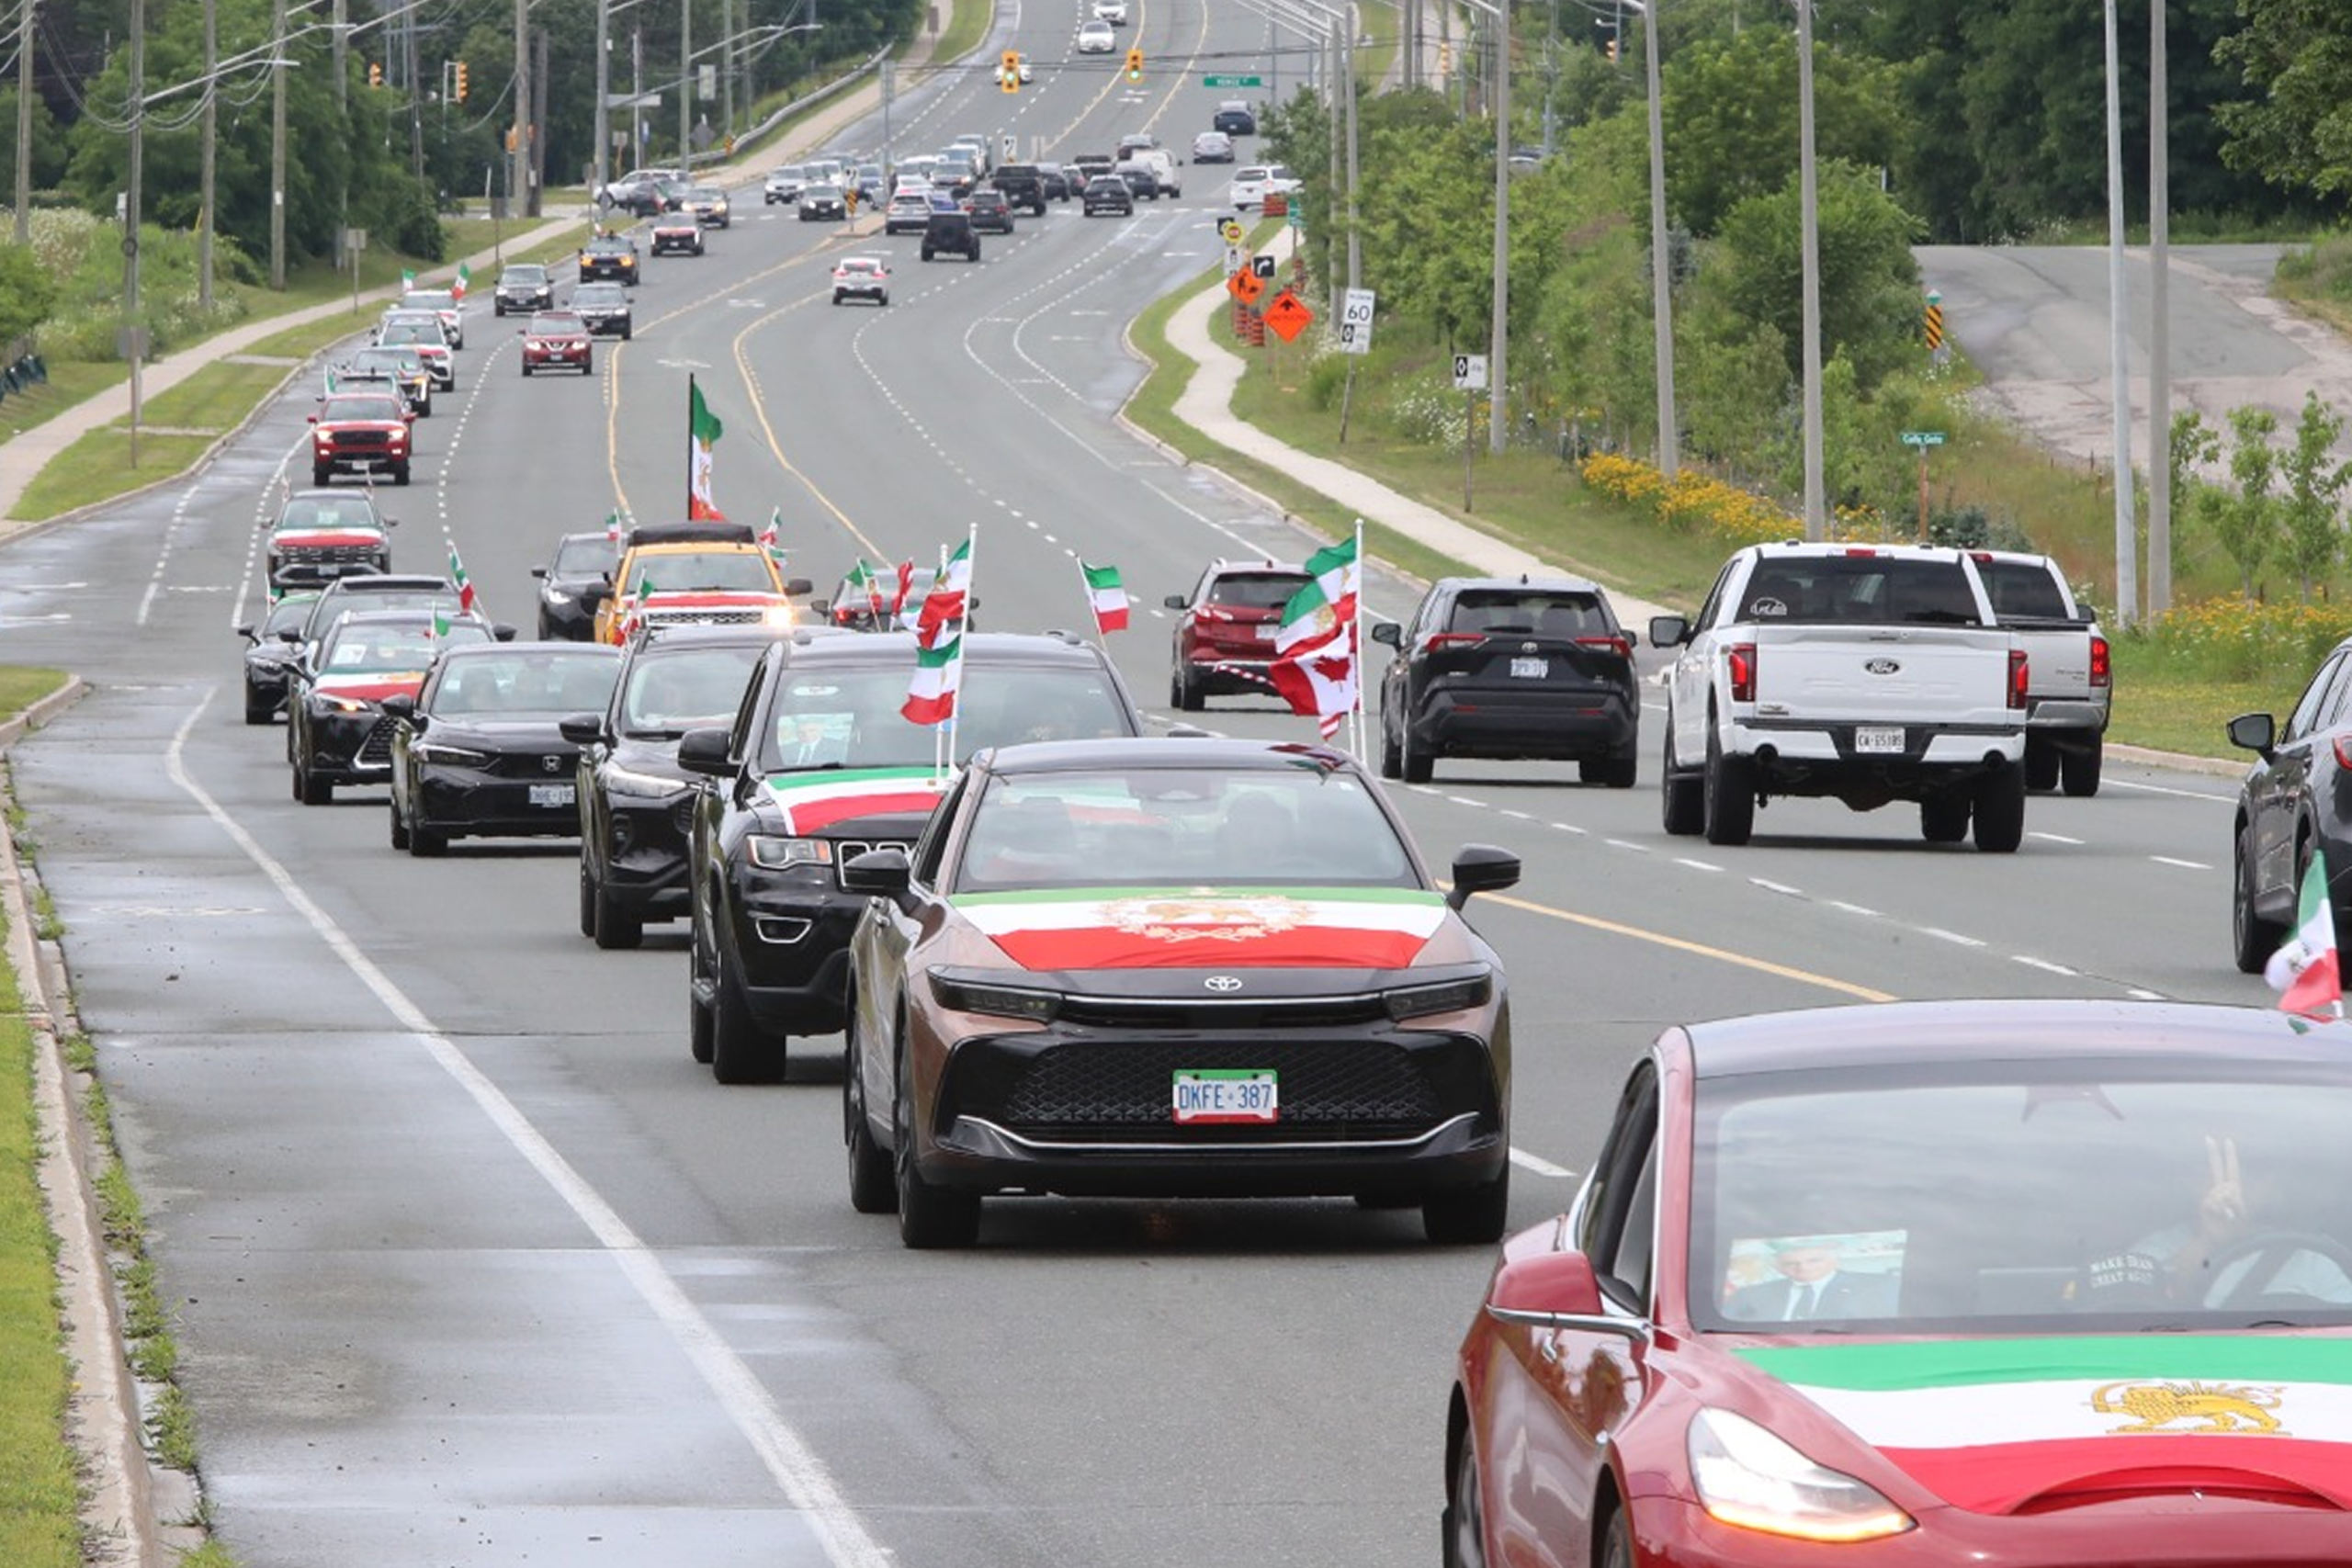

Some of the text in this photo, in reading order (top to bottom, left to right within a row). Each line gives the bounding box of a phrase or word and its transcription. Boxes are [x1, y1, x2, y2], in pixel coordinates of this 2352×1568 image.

[1347, 304, 1371, 322] 60
[1178, 1084, 1271, 1109] DKFE 387
